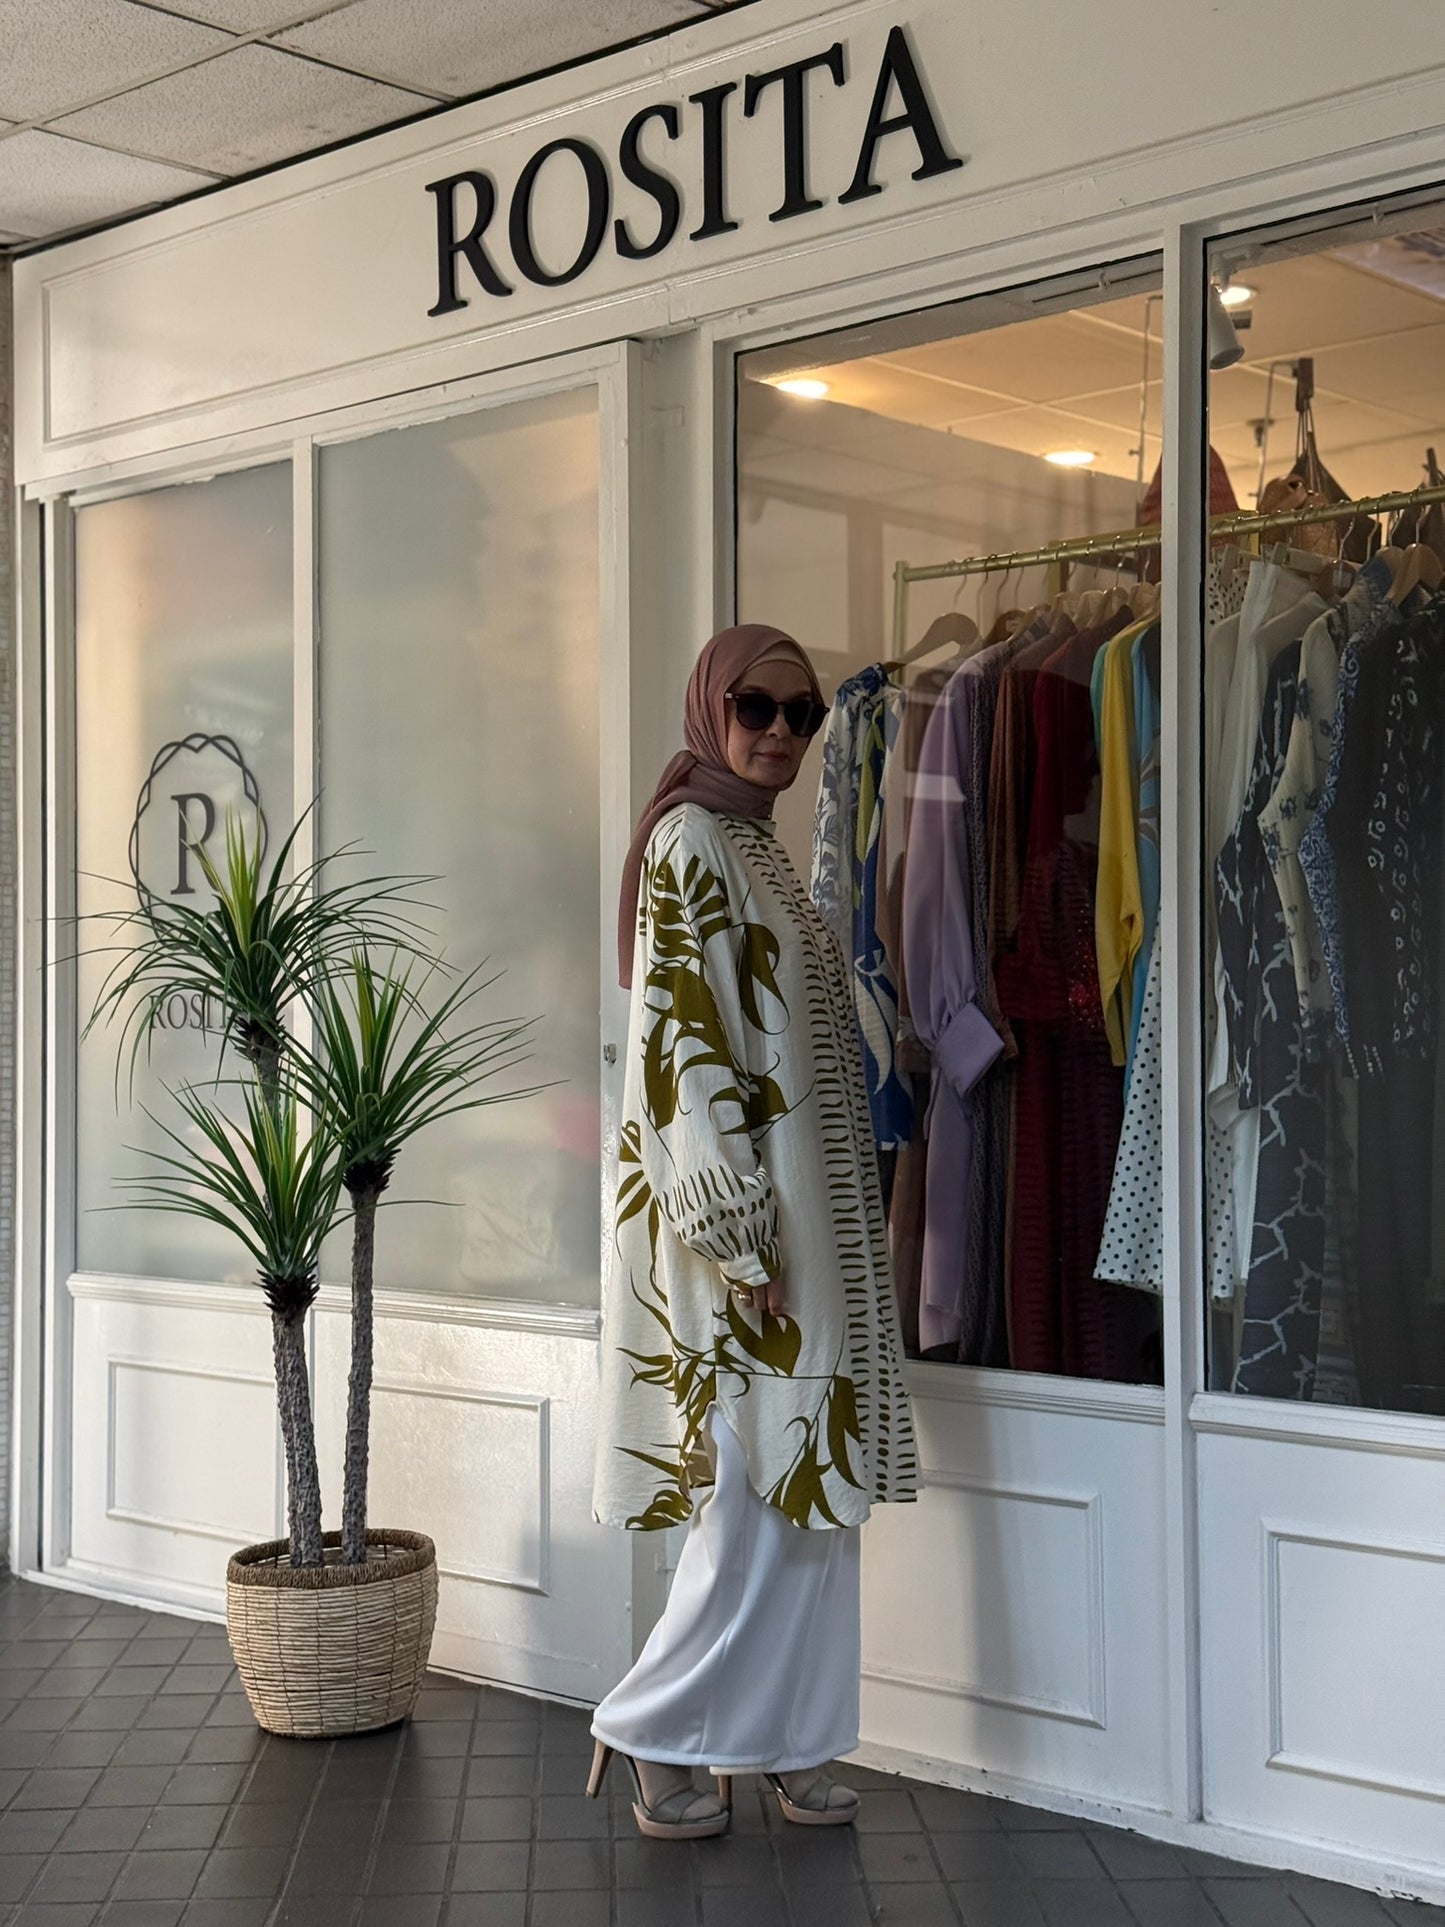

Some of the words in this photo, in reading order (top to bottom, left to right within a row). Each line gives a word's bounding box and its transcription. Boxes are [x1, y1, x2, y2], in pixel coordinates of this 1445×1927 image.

[425, 25, 963, 317] ROSITA
[170, 792, 222, 895] R
[149, 993, 237, 1030] ROSI
